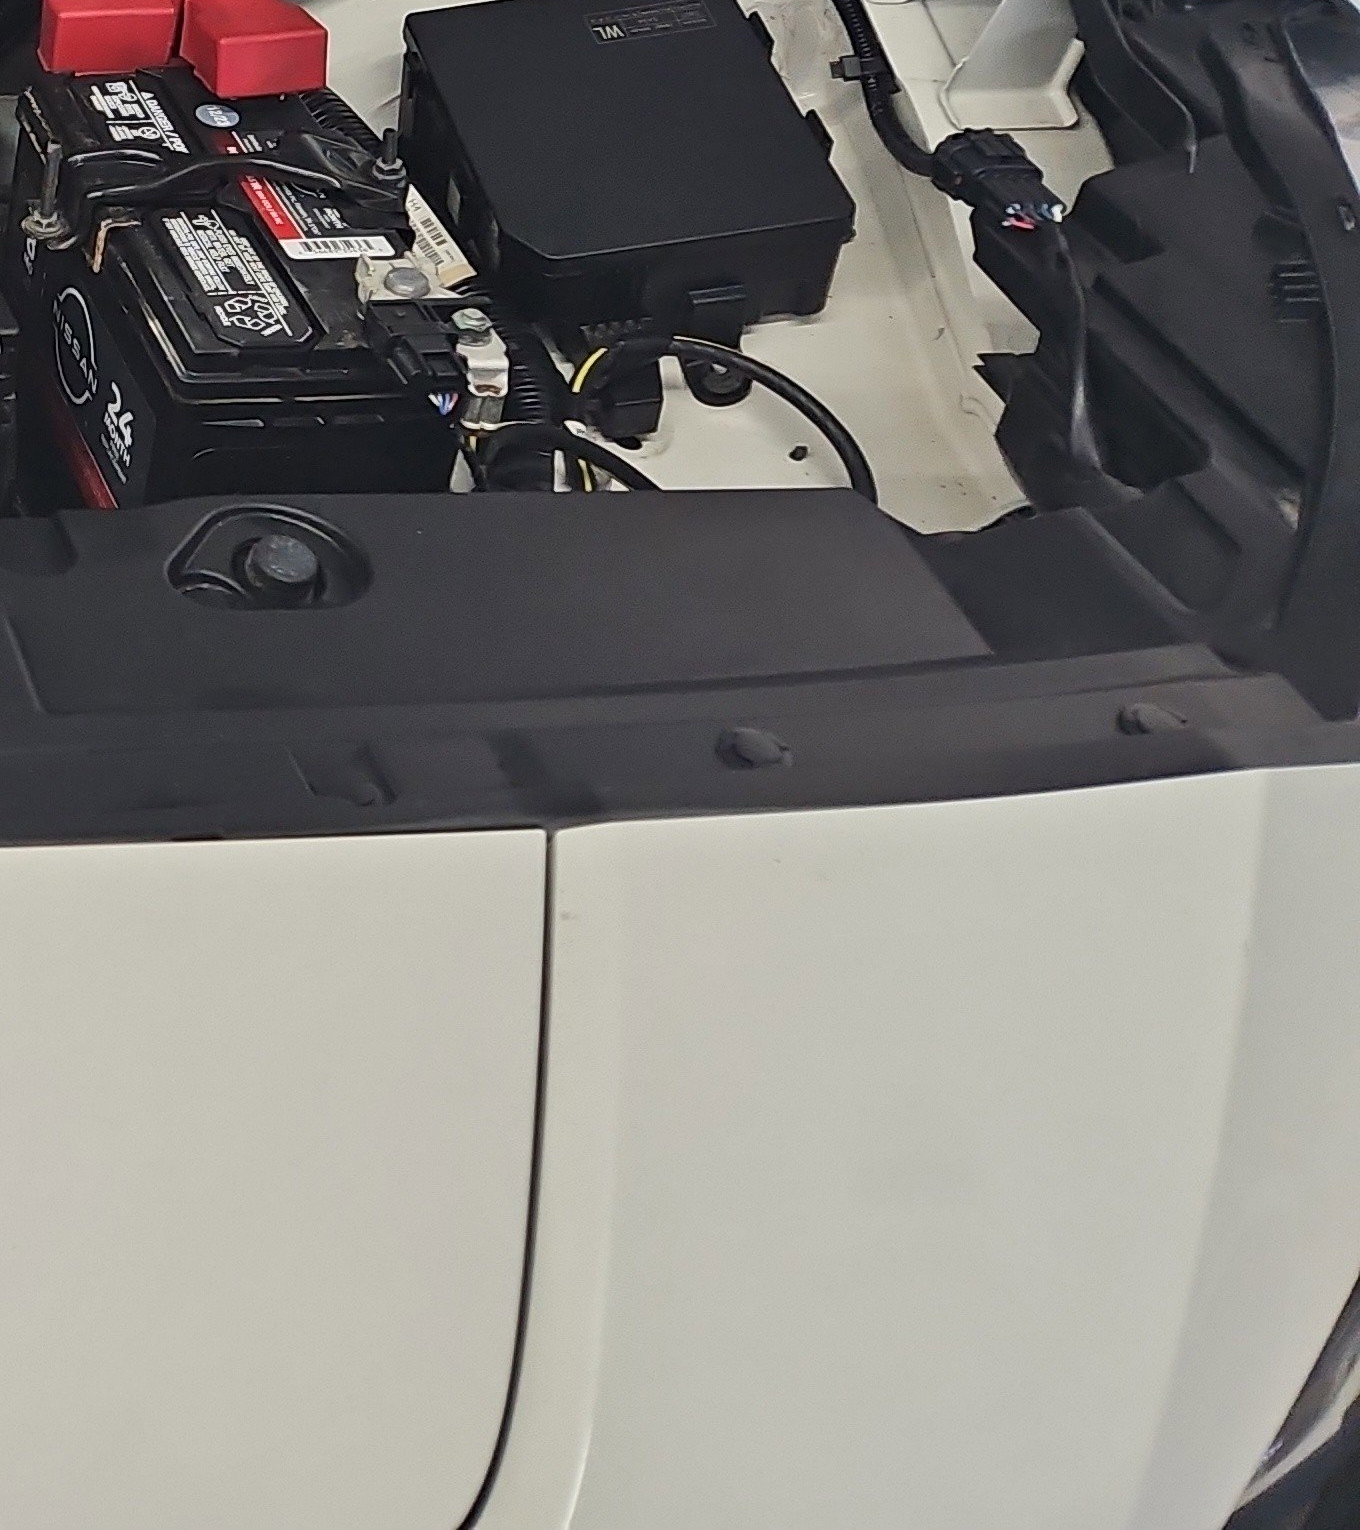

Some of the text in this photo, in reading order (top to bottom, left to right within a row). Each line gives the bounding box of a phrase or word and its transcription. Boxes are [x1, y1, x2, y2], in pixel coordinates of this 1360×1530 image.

[591, 24, 625, 39] WL
[53, 299, 98, 394] NISSAN
[103, 412, 130, 467] MONTH
[107, 381, 134, 446] 24
